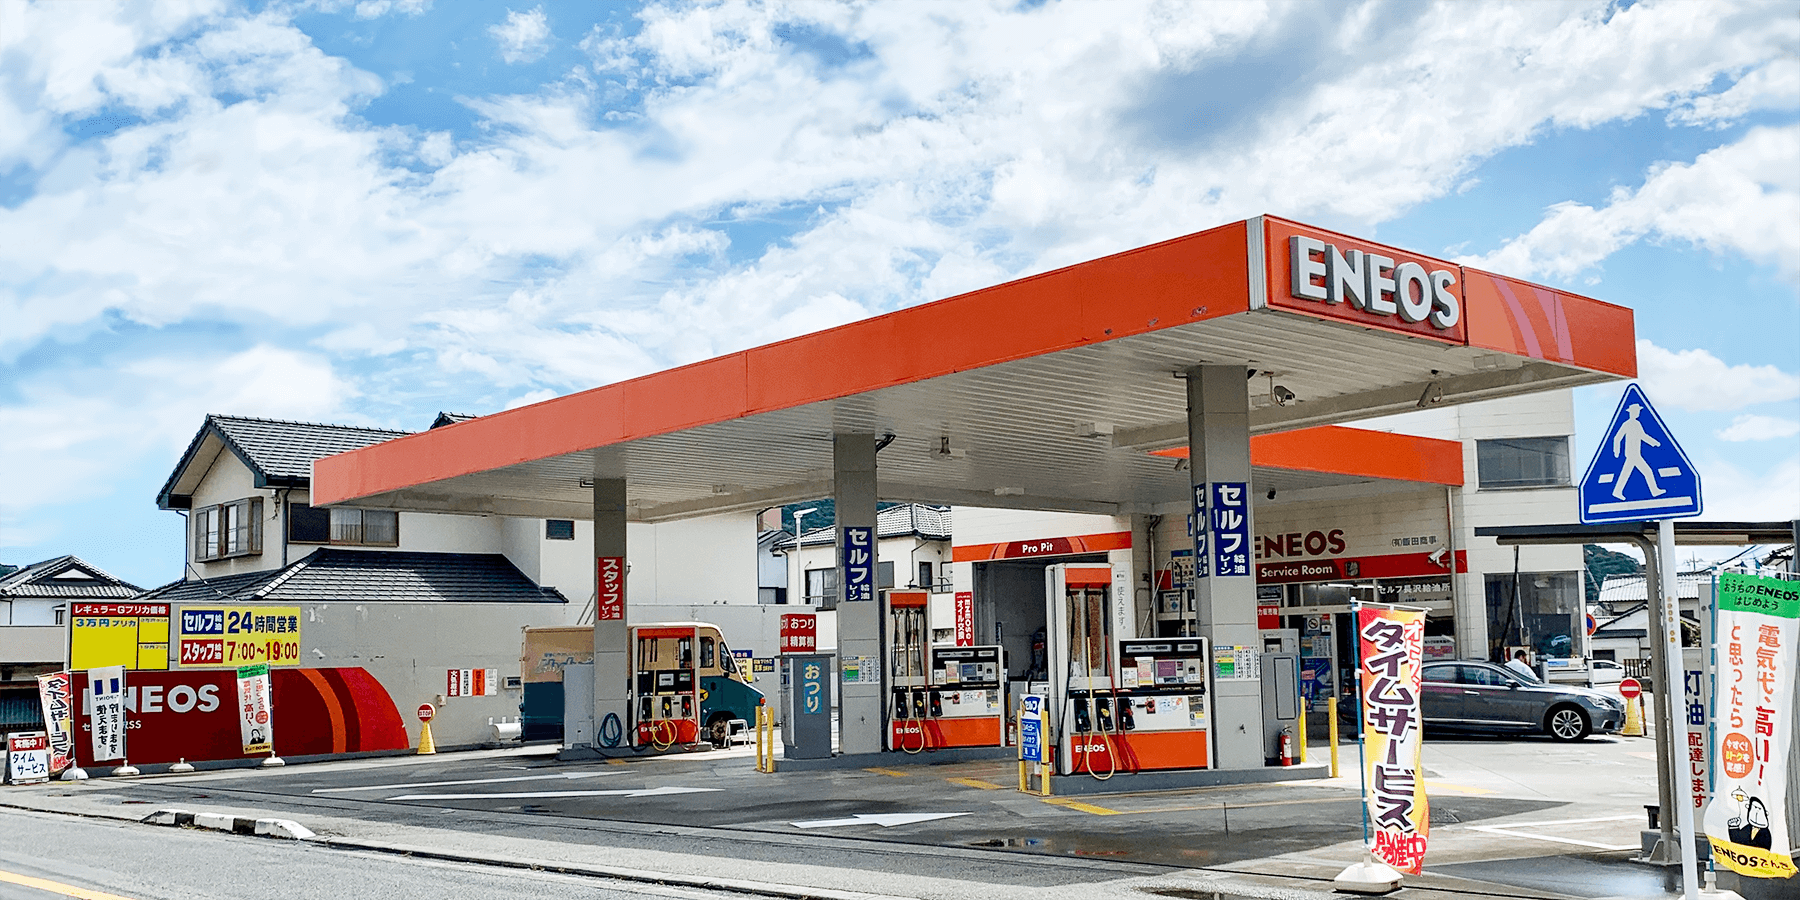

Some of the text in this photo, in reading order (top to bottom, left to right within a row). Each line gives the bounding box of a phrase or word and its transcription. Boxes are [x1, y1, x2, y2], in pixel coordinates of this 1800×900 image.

[1290, 235, 1459, 330] ENEOS
[1196, 487, 1206, 555] セルフ
[1218, 484, 1243, 554] セルフ
[849, 528, 869, 584] セルフ
[1022, 541, 1054, 554] Pro Pit
[1220, 554, 1232, 575] レーン
[1233, 553, 1246, 574] 給油
[1261, 564, 1333, 578] Service Room
[602, 558, 619, 605] スタッフ
[1378, 582, 1451, 595] セルフ長沢給油所
[1724, 579, 1799, 601] おうちのENEOS
[74, 604, 167, 615] レギュラーGプリカ価格
[1734, 595, 1779, 610] はじめよう
[76, 618, 110, 628] 3万円
[112, 620, 137, 628] プリカ
[184, 612, 214, 632] セルフ
[227, 611, 298, 633] 24時間営業
[790, 618, 815, 630] おつり
[183, 642, 214, 662] スタッフ
[1729, 621, 1745, 728] と思ったら
[804, 663, 821, 713] おつり
[1684, 669, 1705, 726] 灯油
[1362, 617, 1416, 834] タイムサービス
[13, 752, 35, 764] タイム
[17, 763, 46, 775] サービス
[1688, 732, 1707, 808] 配達します
